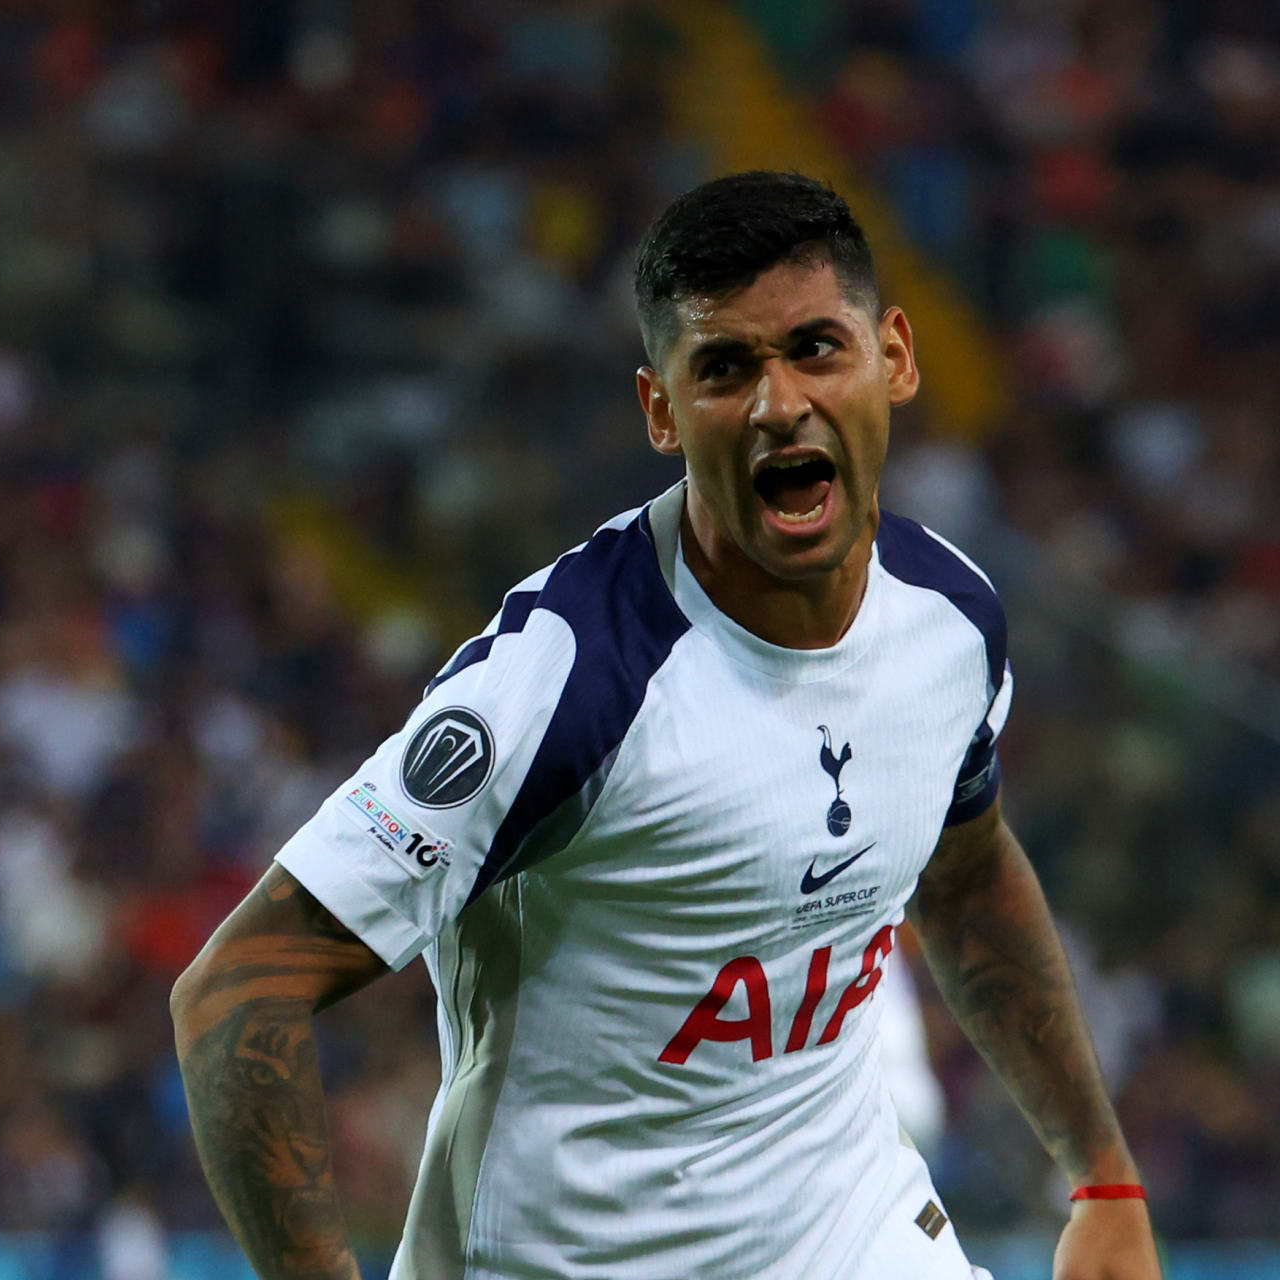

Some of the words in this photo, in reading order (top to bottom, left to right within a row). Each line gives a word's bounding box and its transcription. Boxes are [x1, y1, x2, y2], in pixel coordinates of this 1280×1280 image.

[348, 788, 408, 841] FOUNDATION
[795, 900, 822, 914] UEFA
[823, 891, 857, 908] SUPER
[857, 886, 881, 900] CUP
